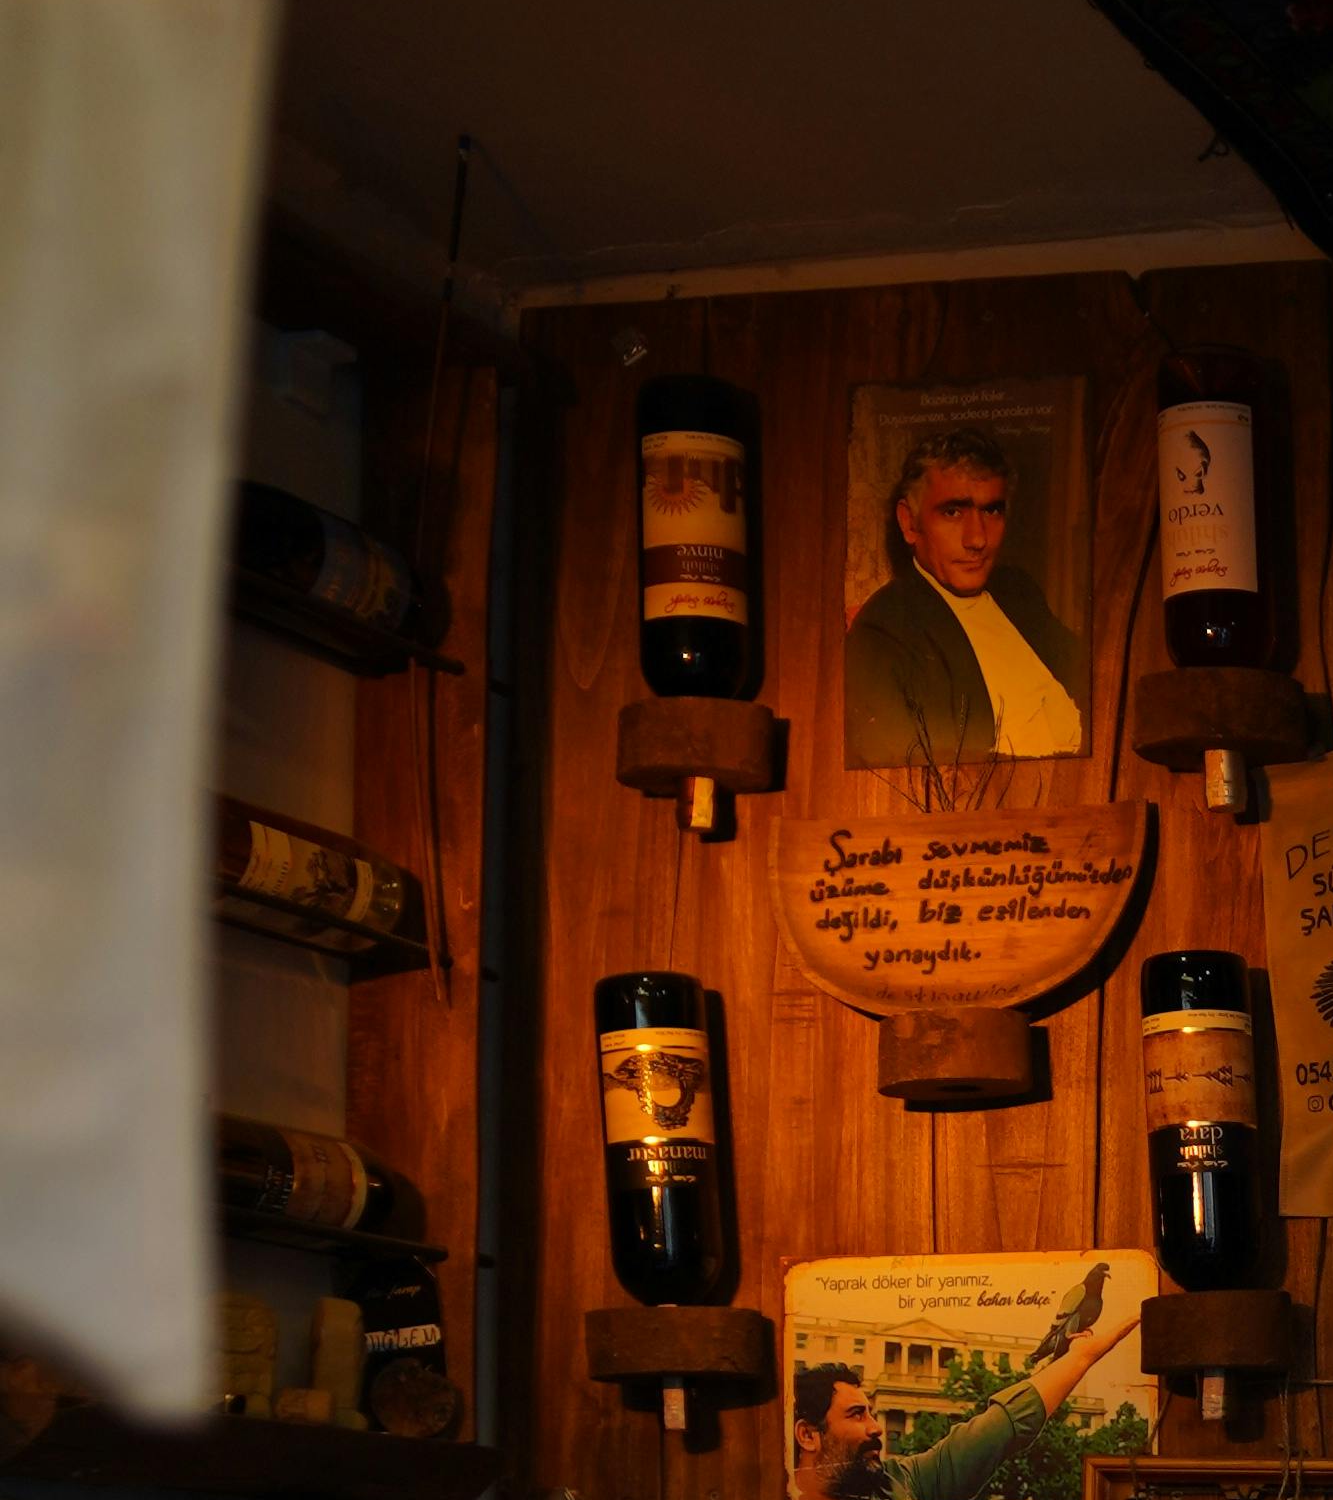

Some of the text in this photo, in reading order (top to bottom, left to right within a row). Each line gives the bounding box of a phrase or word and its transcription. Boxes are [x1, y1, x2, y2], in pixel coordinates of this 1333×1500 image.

[1168, 503, 1225, 524] verdo
[677, 544, 724, 561] ninve
[810, 878, 891, 903] üzüme
[918, 899, 963, 924] biz
[1179, 1126, 1224, 1145] dara
[871, 1273, 911, 1290] döker
[915, 1273, 934, 1289] bir
[898, 1294, 916, 1309] bir
[920, 1294, 971, 1312] yanımız
